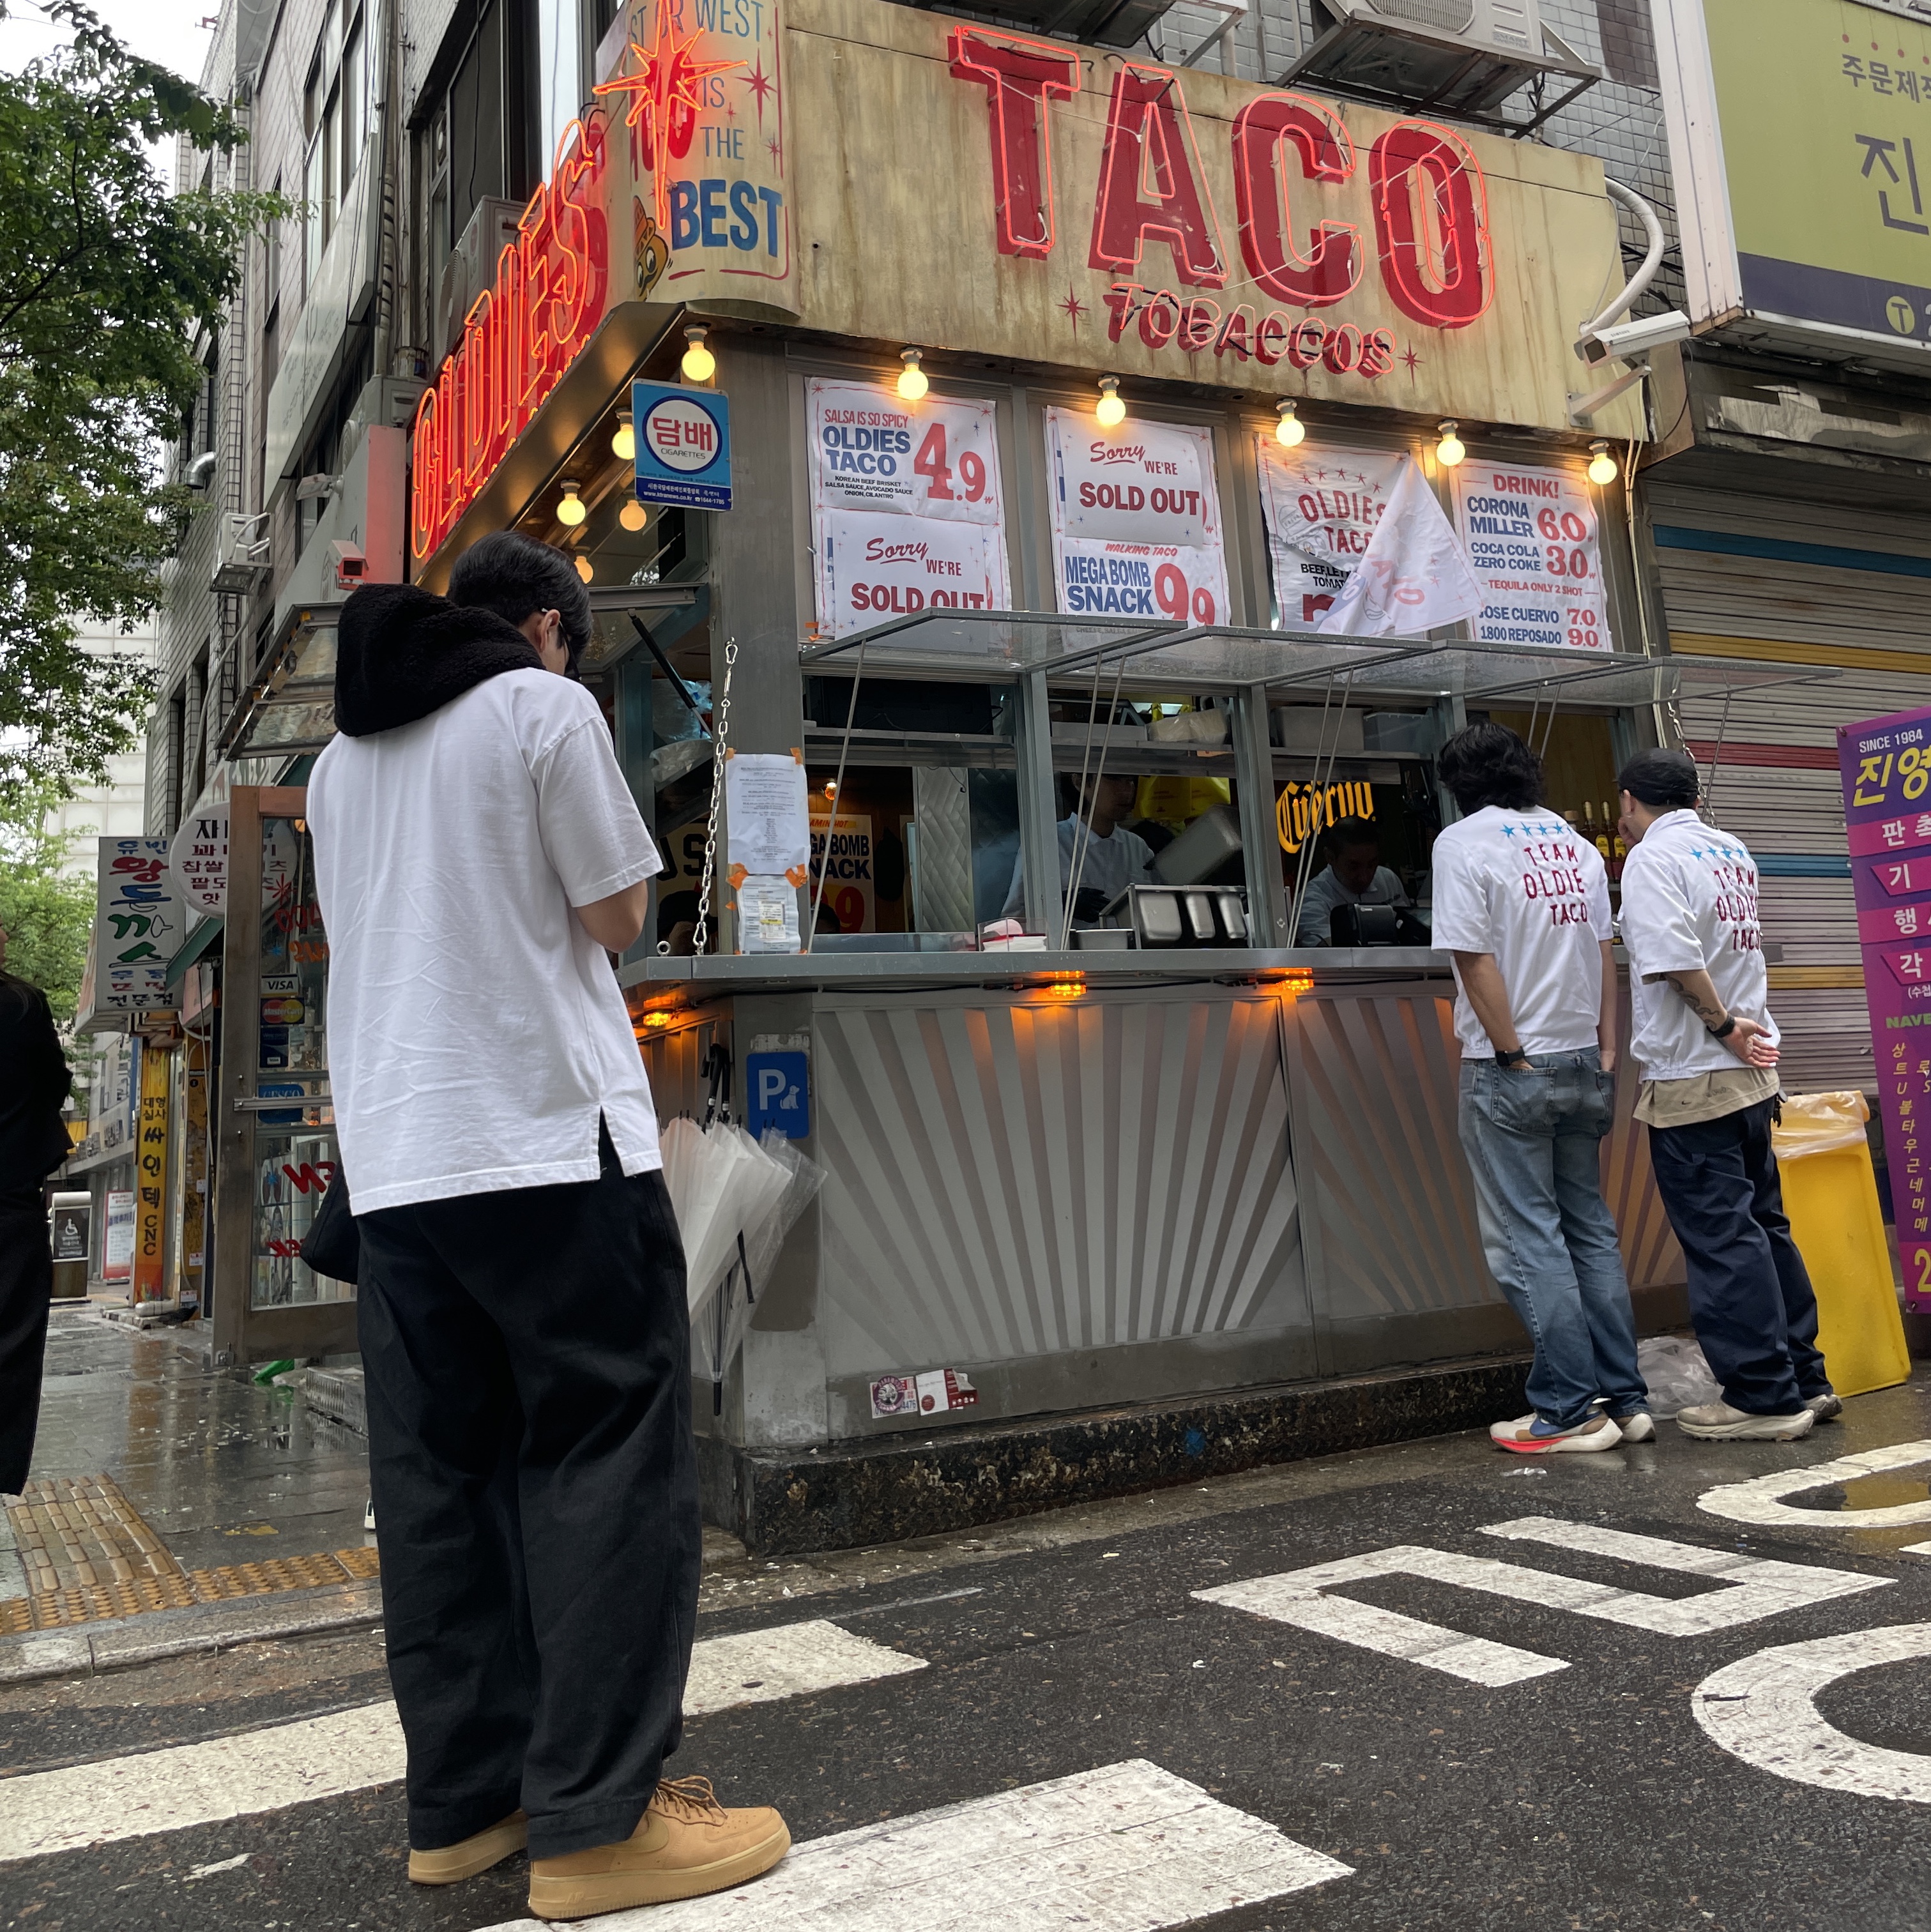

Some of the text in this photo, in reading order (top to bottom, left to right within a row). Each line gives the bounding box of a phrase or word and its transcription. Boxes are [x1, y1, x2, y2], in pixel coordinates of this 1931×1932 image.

[696, 0, 763, 42] WEST
[703, 76, 724, 108] IS
[699, 126, 745, 160] THE
[947, 24, 1496, 330] TACO
[1854, 133, 1929, 236] 진
[670, 179, 783, 258] BEST
[412, 118, 599, 559] OLDIES
[1103, 283, 1397, 379] TOBACCOS
[825, 409, 908, 428] SALSA IS SO SPICY
[653, 417, 712, 451] 담배
[823, 426, 910, 453] OLDIES
[660, 448, 705, 459] CIGARETTES
[825, 449, 896, 476] TACO
[913, 423, 986, 503] 4.9
[1090, 442, 1177, 475] Sorry WE'RE
[1080, 482, 1199, 515] SOLD OUT
[1493, 475, 1559, 499] DRINK!
[1467, 496, 1530, 519] CORONA
[1470, 517, 1535, 538] MILLER
[866, 538, 961, 575] Sorry WE'RE
[1105, 544, 1177, 556] WALKING TACO
[1471, 542, 1539, 558] COCA COLA
[1065, 556, 1151, 588] MEGA BOMB
[1473, 557, 1541, 571] ZERO COKE
[851, 582, 984, 614] SOLD OUT
[1067, 586, 1154, 614] SNACK
[1488, 580, 1582, 597] TEQUILA ONLY 2 SHOT
[1479, 605, 1559, 623] JOSE CUERVO
[1481, 626, 1561, 644] 1800 REPOSADO
[1859, 728, 1923, 754] SINCE 1984
[834, 820, 848, 828] HOT
[118, 840, 167, 855] 유빈
[830, 834, 870, 856] BOMB
[1523, 843, 1578, 867] TEAM
[1523, 868, 1585, 900] OLDIE
[1714, 867, 1754, 890] TEAM
[1550, 902, 1587, 926] TACO
[268, 981, 293, 990] VISA
[107, 993, 173, 1007] 전문점
[143, 1097, 166, 1107] 대형
[758, 1069, 786, 1110] P
[143, 1108, 166, 1121] 실사
[143, 1215, 157, 1256] CNC
